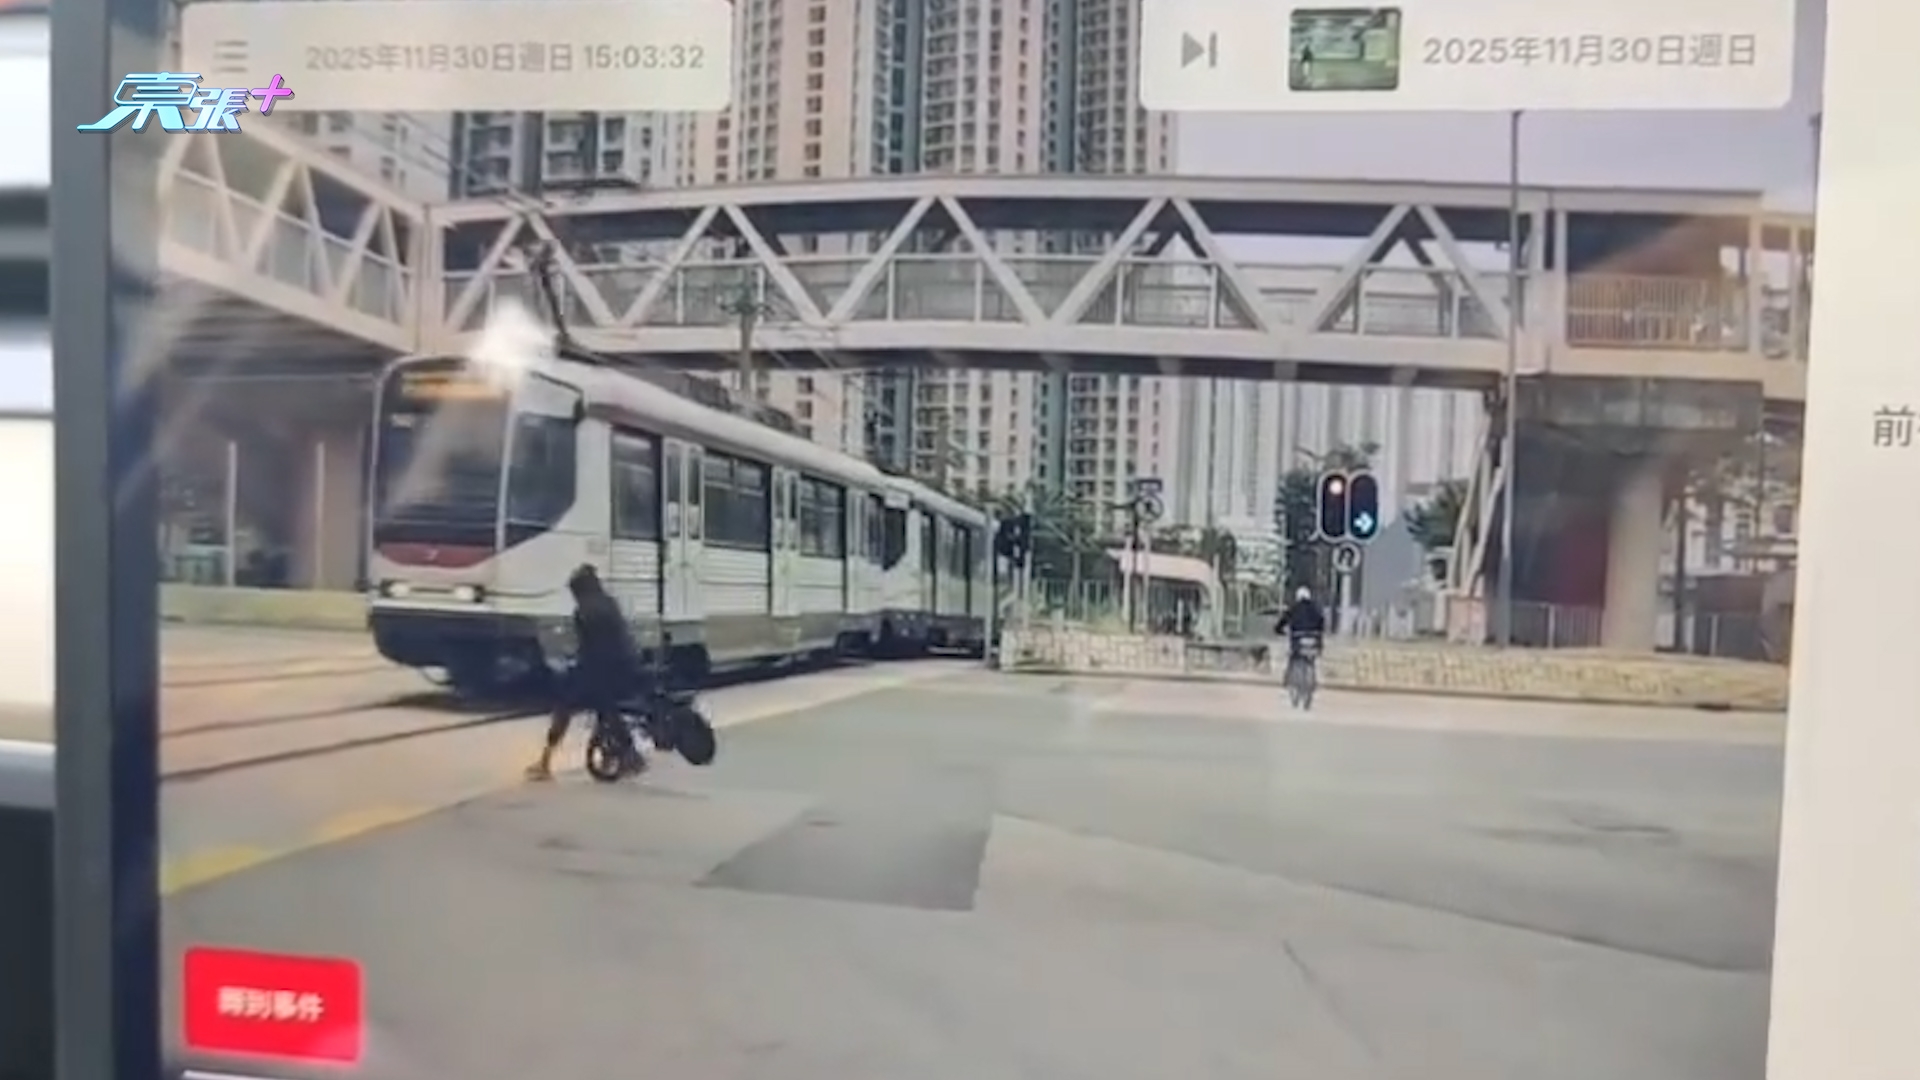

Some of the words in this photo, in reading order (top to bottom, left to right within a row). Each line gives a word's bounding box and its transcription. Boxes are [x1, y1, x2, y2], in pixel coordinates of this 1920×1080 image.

[305, 43, 573, 71] 2025年11月30日週日
[584, 44, 705, 70] 15:03:32
[1422, 33, 1757, 66] 2025年11月30日週日
[1873, 404, 1920, 448] 前
